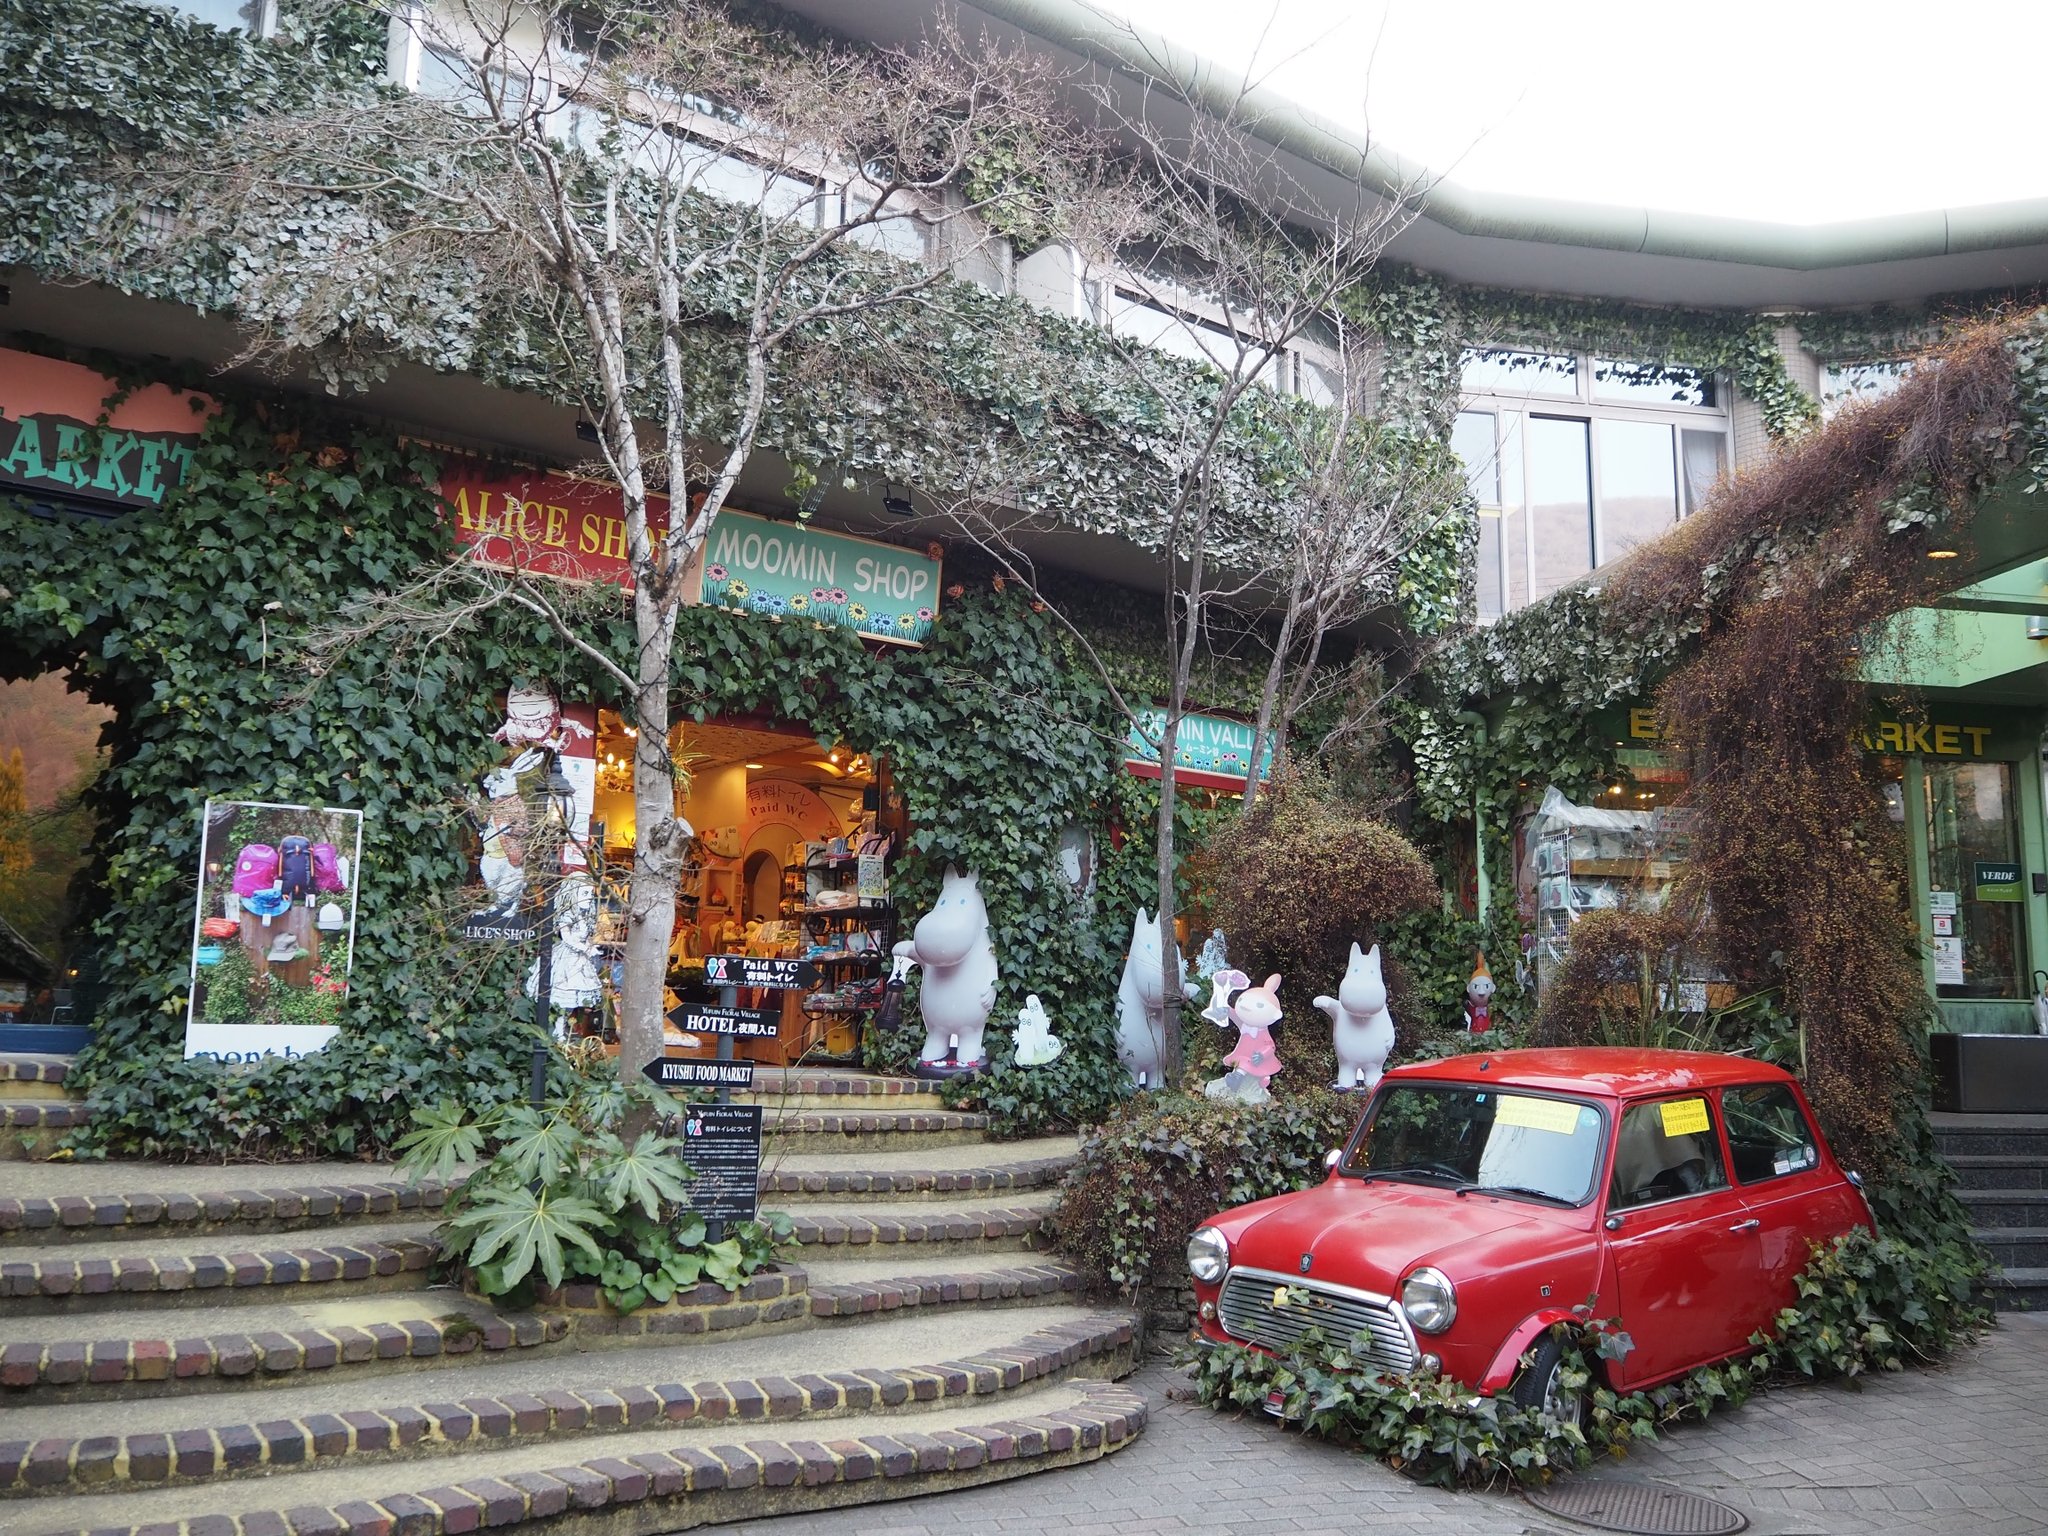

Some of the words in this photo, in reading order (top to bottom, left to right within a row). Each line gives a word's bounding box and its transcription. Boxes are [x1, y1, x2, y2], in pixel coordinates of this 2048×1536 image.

[0, 407, 196, 504] ARKET
[454, 486, 569, 548] ALICE
[714, 527, 837, 586] MOOMIN
[853, 557, 929, 602] SHOP
[750, 803, 779, 816] Paid
[786, 804, 808, 820] WC
[1982, 871, 2015, 881] VERDE
[462, 926, 501, 939] LICE'S
[503, 928, 536, 941] SHOP
[743, 959, 769, 971] Paid
[775, 961, 798, 973] WC
[686, 1014, 738, 1034] HOTEL
[662, 1064, 696, 1079] KYUSHU
[696, 1065, 719, 1080] FOOD
[719, 1066, 752, 1082] MARKET
